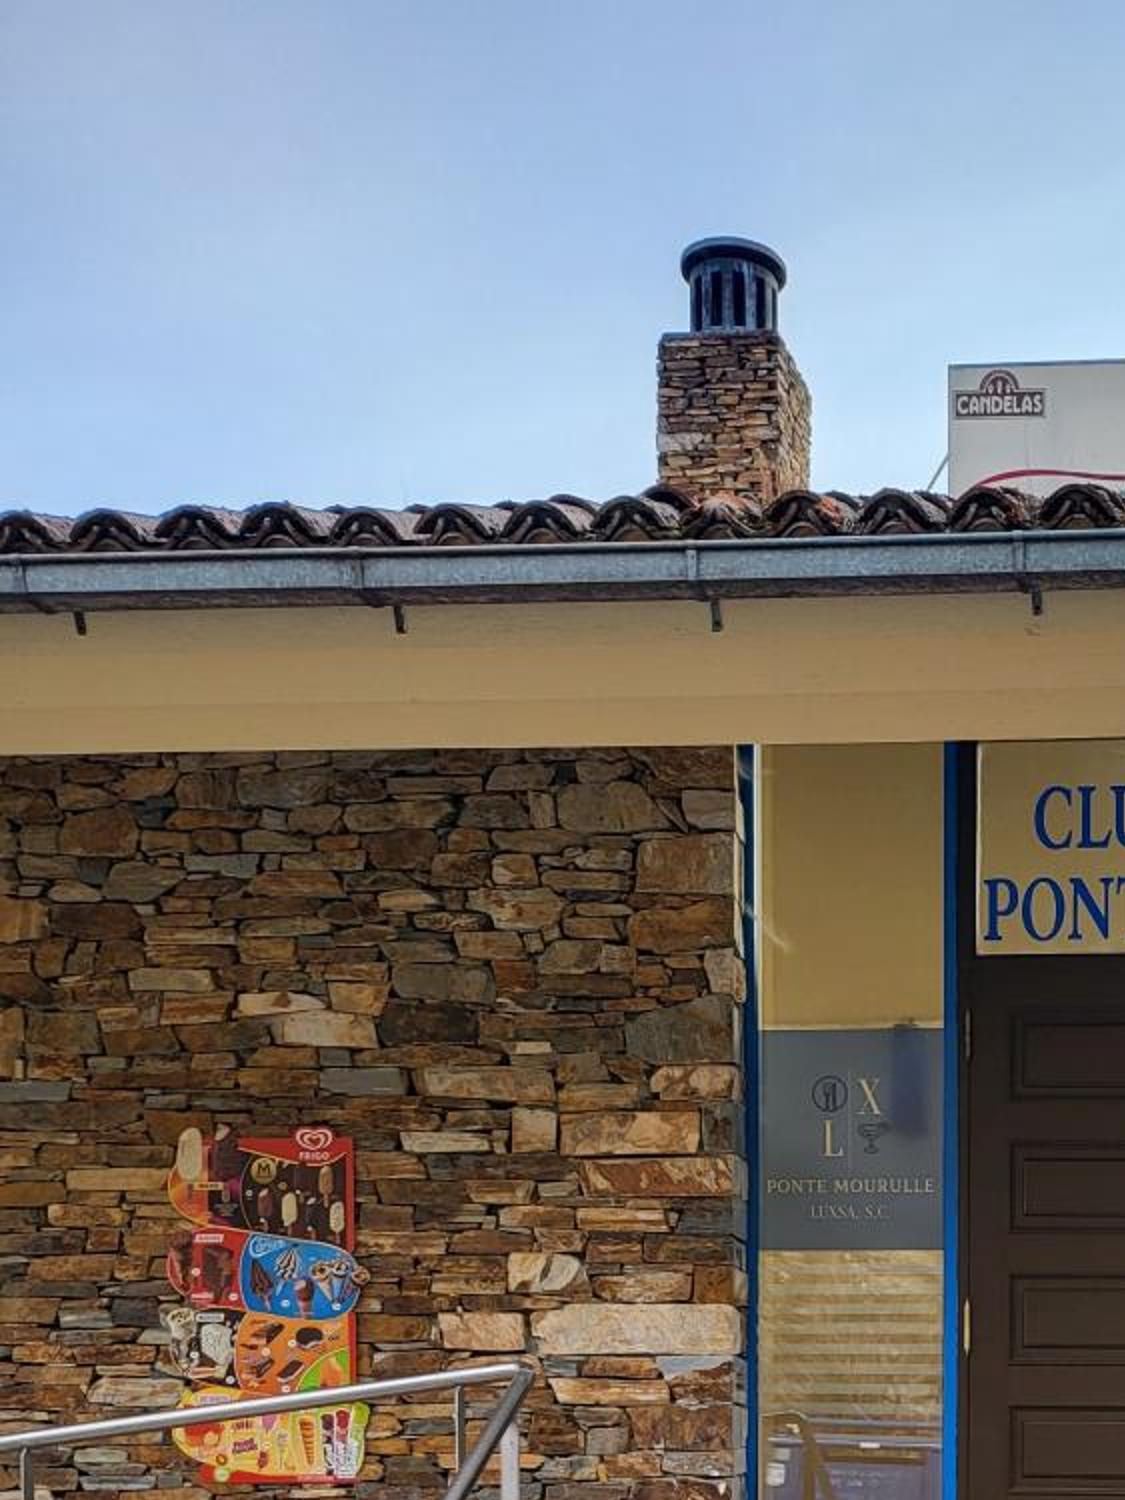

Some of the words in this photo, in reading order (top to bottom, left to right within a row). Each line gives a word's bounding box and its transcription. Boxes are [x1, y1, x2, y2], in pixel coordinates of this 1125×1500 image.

[957, 391, 1044, 416] CANDELAS
[299, 1151, 331, 1161] FRIGO
[767, 1178, 828, 1194] PONTE
[834, 1178, 936, 1194] MOURULLE
